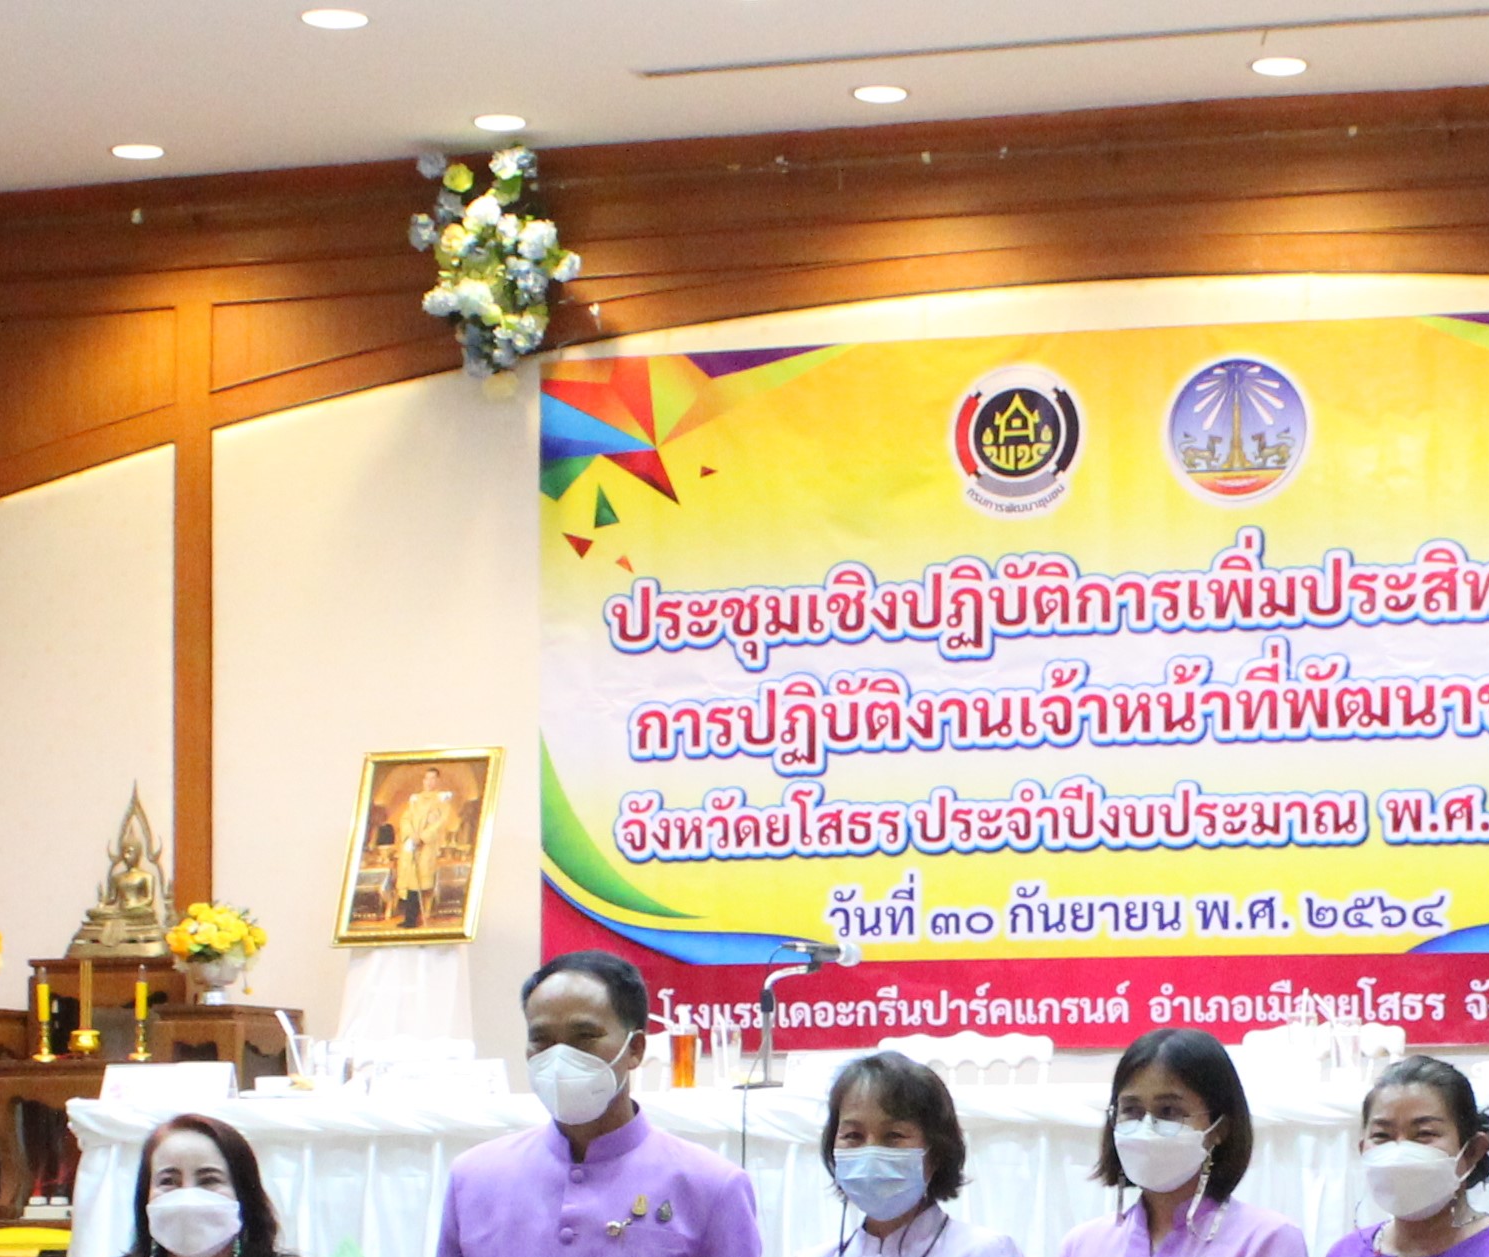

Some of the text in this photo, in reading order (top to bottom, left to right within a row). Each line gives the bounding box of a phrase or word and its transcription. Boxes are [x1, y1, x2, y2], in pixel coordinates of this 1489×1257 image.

[624, 791, 899, 851] จังหวัดยโสธร
[920, 785, 1355, 842] ประจำปีงบประมาณ
[1391, 796, 1489, 832] พ.ศ.
[830, 875, 1444, 935] วันที่ ๓๐ กันยายน พ.ศ. ๒๕๖๔
